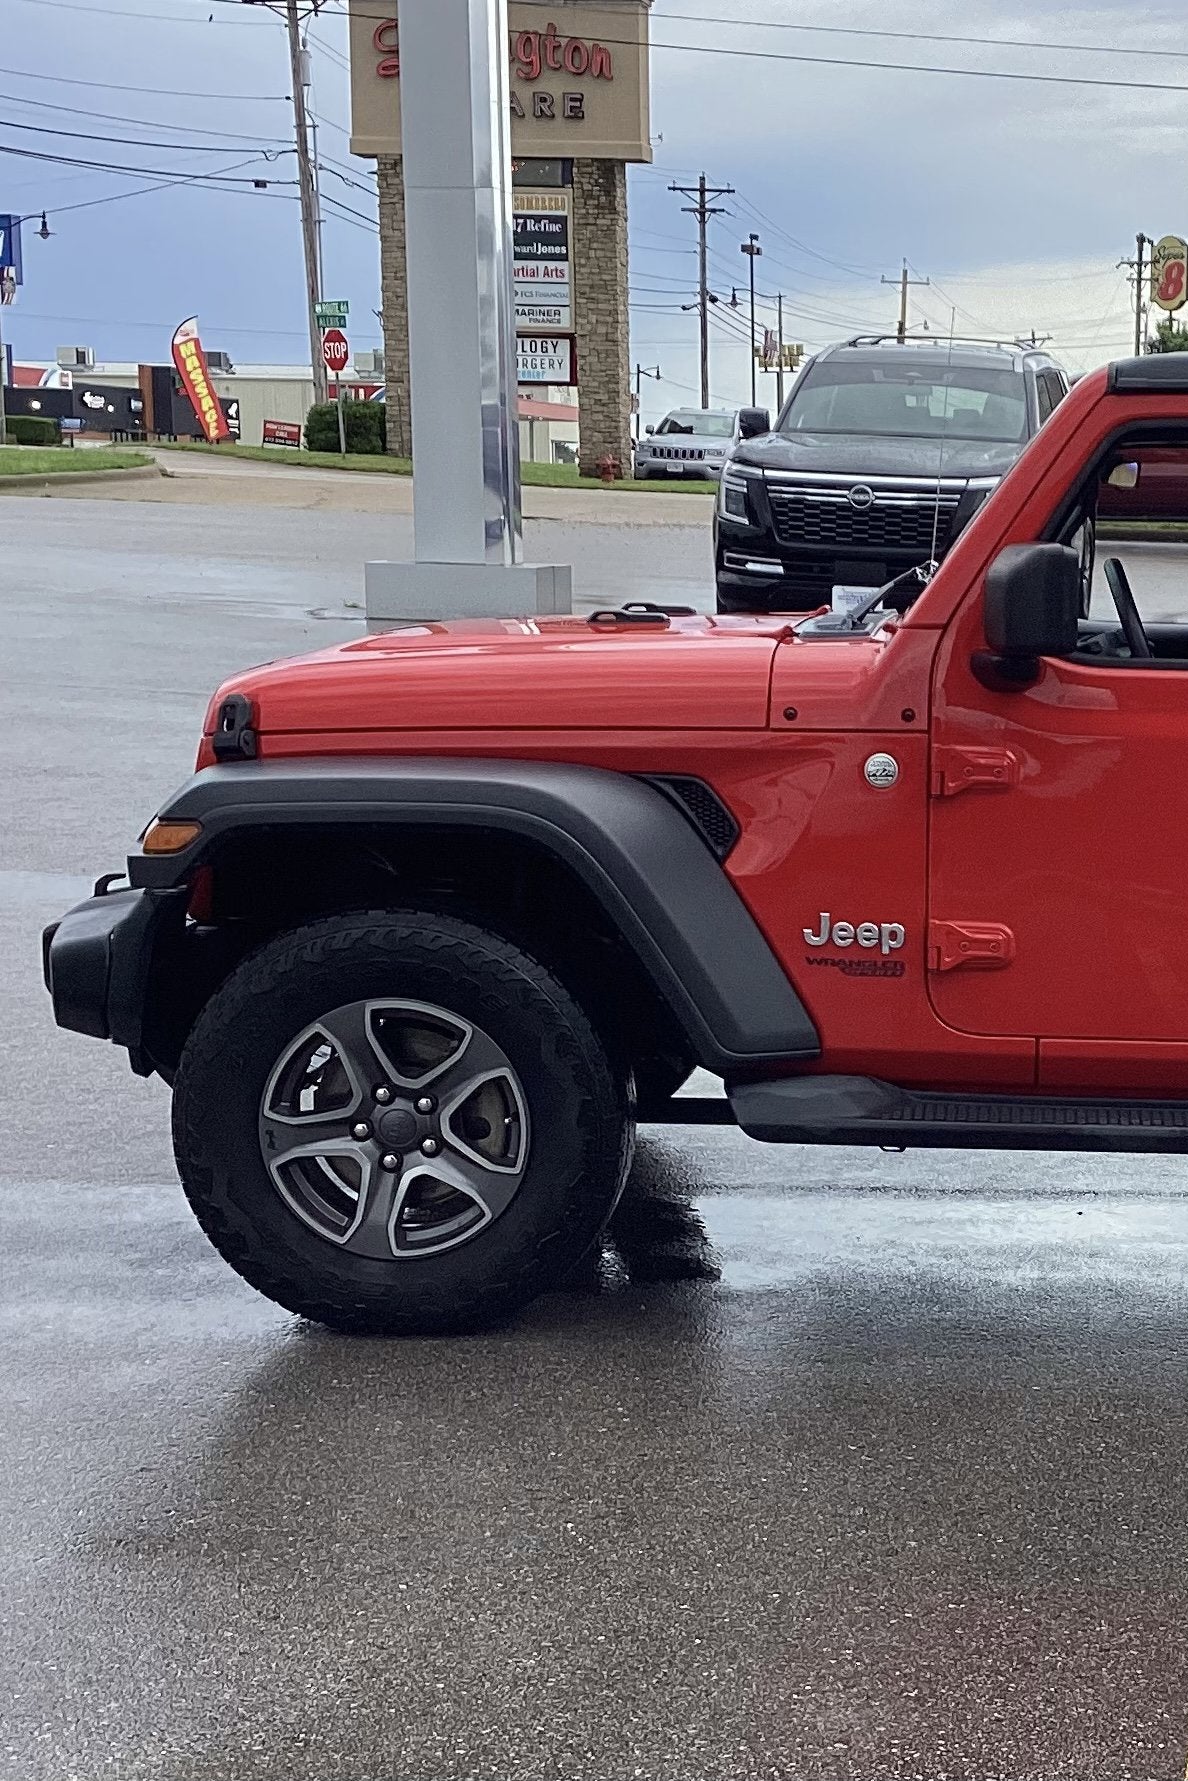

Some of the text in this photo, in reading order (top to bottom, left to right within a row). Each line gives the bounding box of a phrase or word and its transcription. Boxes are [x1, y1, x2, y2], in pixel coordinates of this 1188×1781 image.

[526, 219, 563, 233] Refine
[542, 265, 566, 279] Arts
[1157, 261, 1185, 300] 8
[528, 317, 562, 325] FINANCE
[324, 341, 347, 359] STOP
[178, 339, 219, 439] MASSAGE
[803, 912, 905, 954] Jeep
